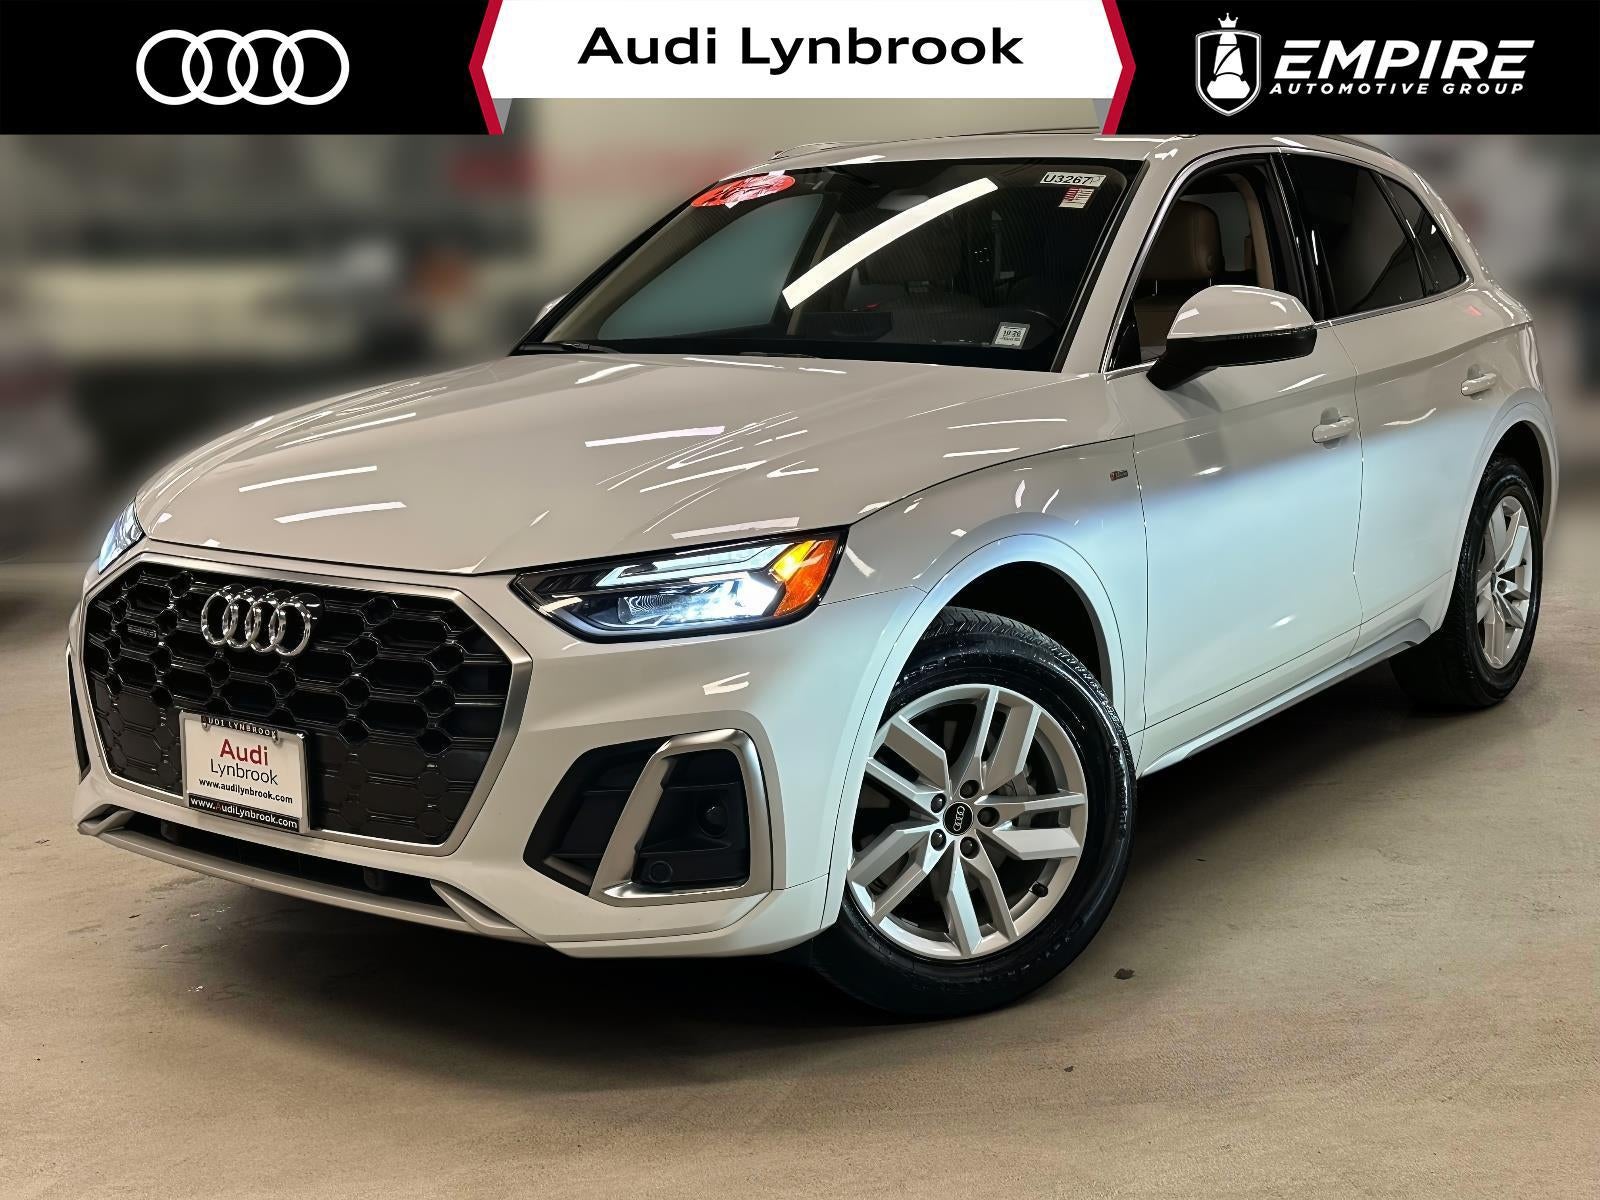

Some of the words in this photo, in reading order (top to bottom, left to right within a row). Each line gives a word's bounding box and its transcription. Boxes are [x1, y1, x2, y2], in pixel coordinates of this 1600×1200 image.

[220, 738, 268, 766] Audi
[211, 758, 278, 785] Lynbrook
[199, 779, 293, 804] www.audilynbrook.com
[190, 797, 298, 829] www.AudiLynbrook.com
